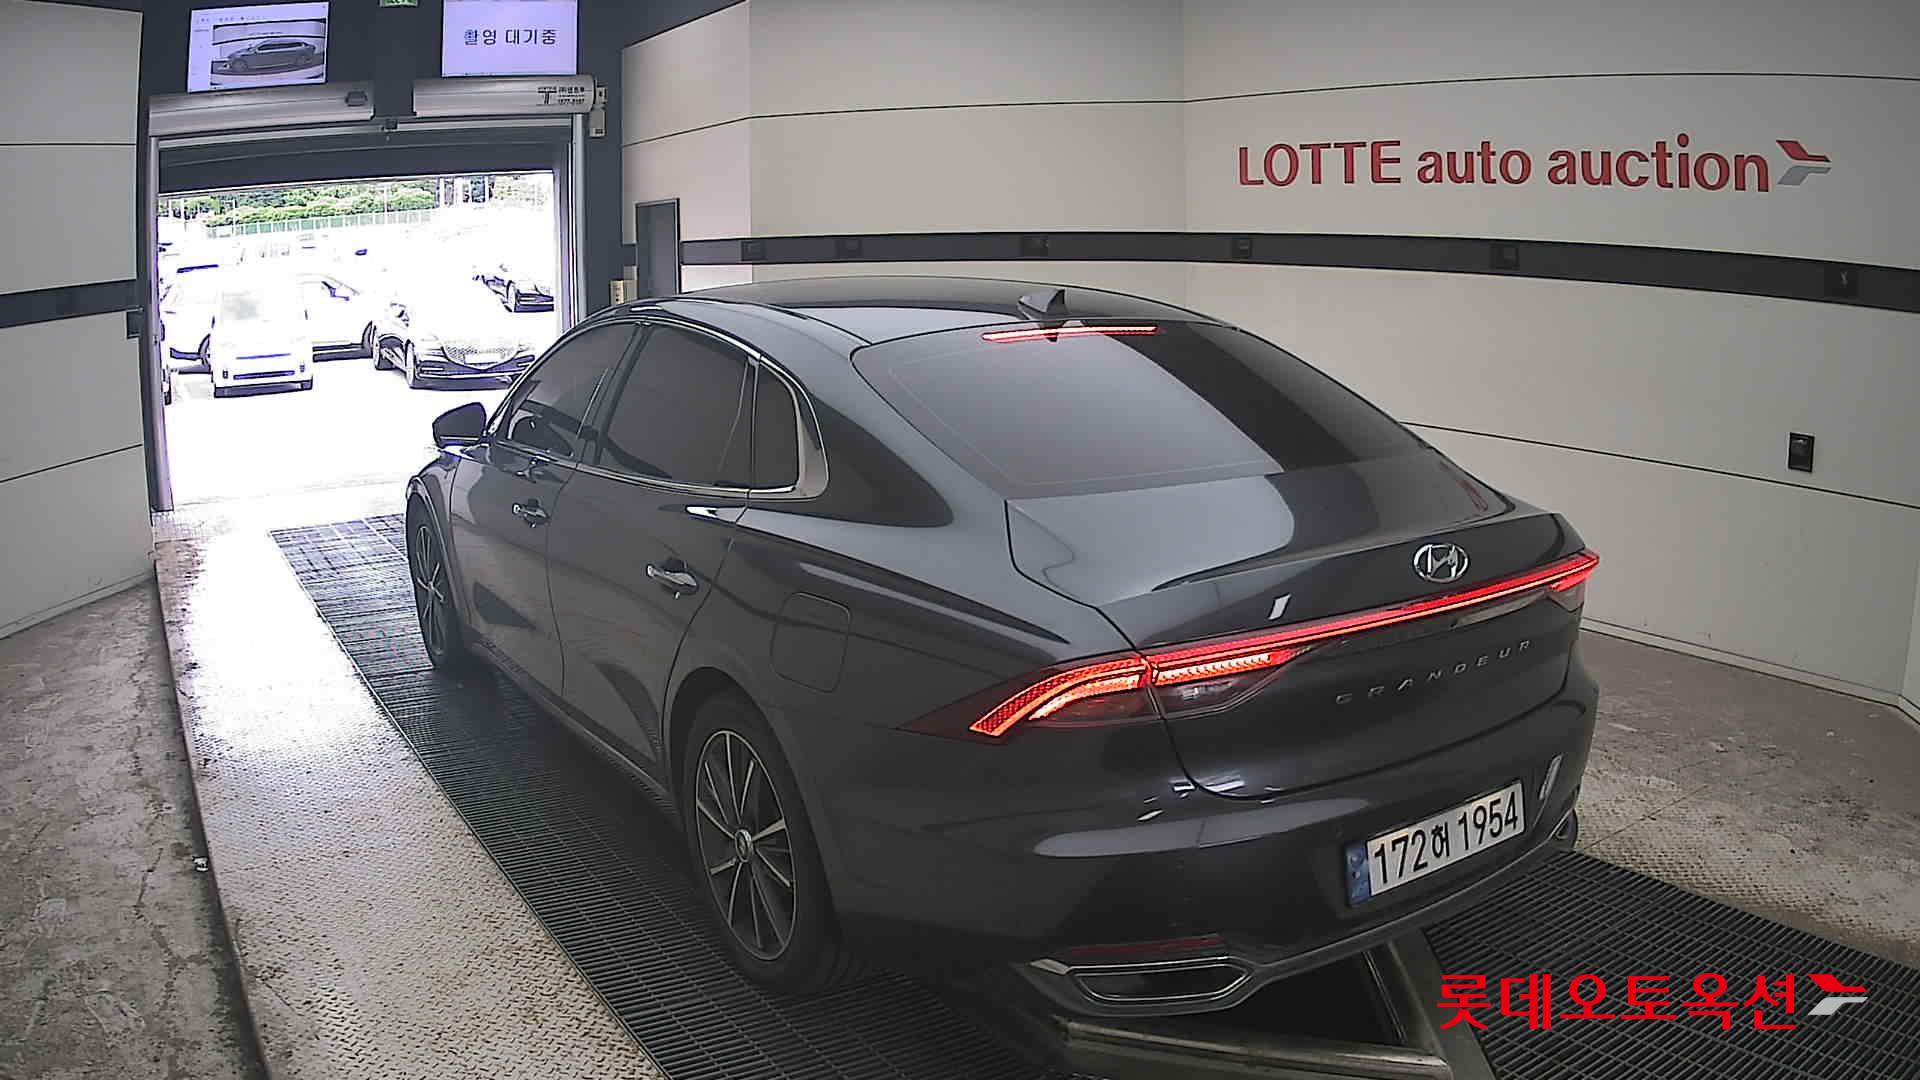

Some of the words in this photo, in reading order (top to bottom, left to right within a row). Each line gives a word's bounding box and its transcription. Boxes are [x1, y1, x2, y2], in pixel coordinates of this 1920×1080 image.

[505, 28, 556, 46] 대기중
[1239, 140, 1401, 187] LOTTE
[1416, 140, 1532, 185] auto
[1547, 133, 1769, 193] auction
[1336, 640, 1530, 705] GRANDEUR
[1374, 822, 1450, 884] 172허
[1458, 791, 1518, 851] 1954
